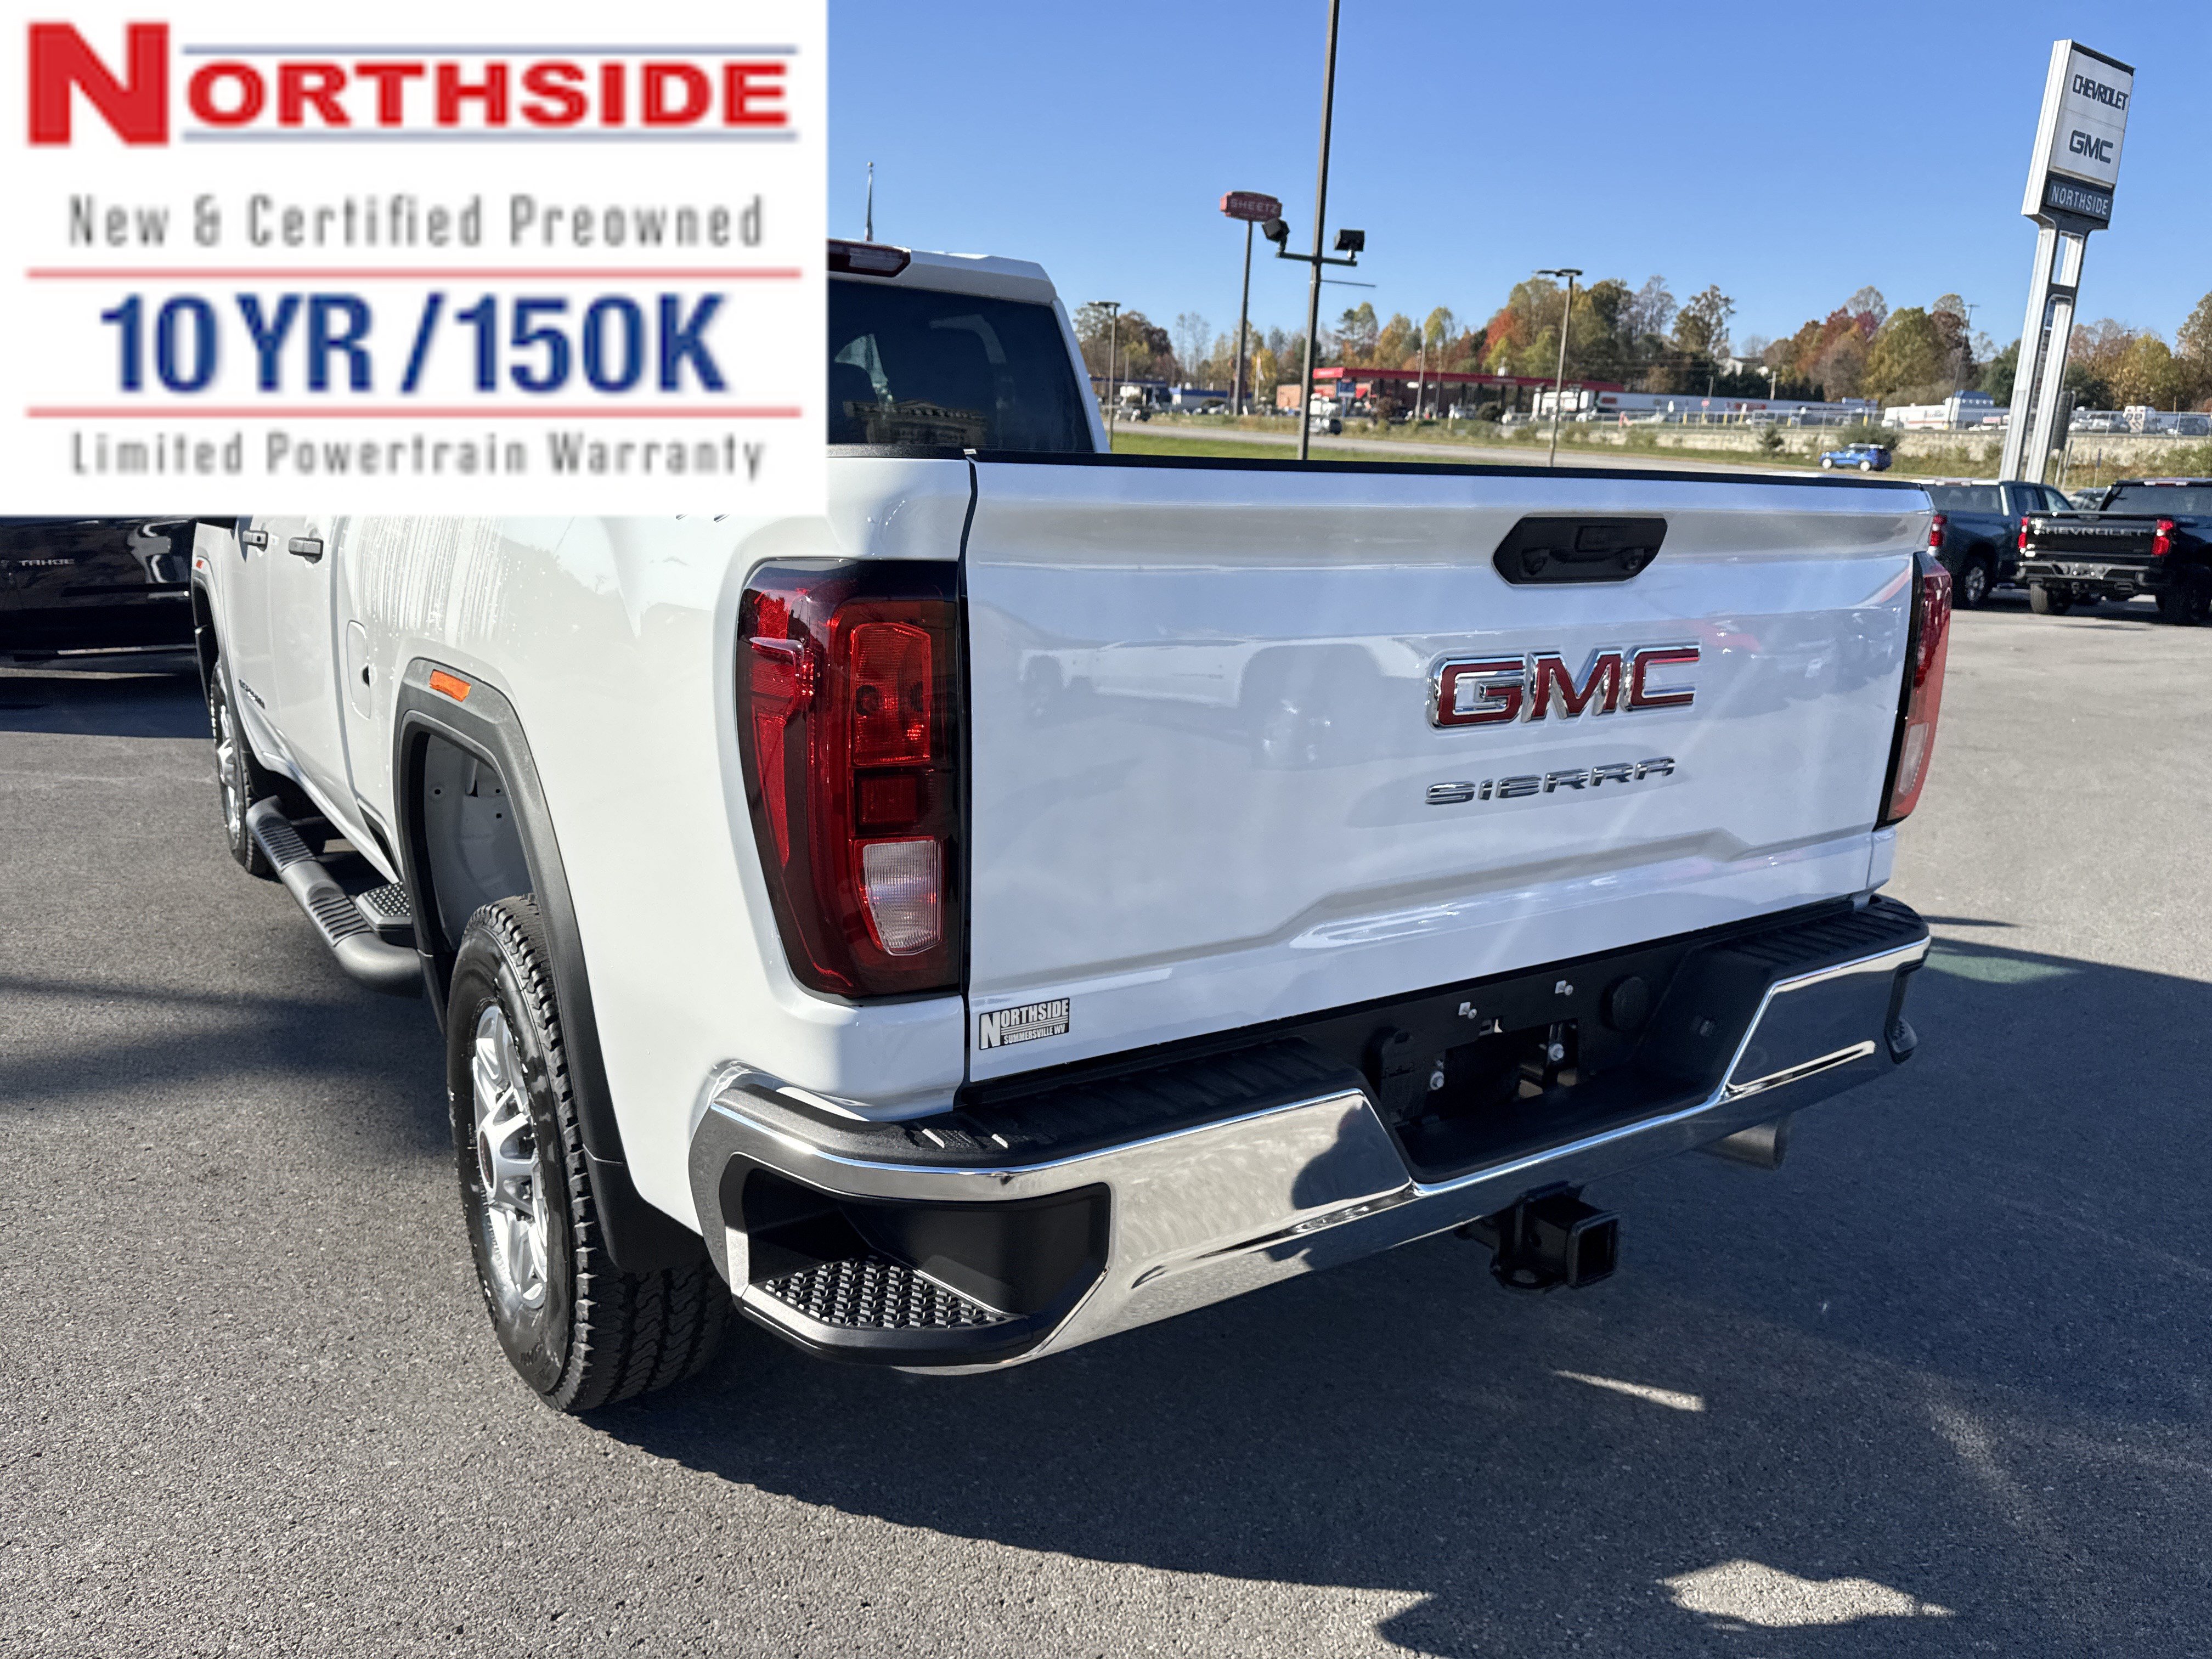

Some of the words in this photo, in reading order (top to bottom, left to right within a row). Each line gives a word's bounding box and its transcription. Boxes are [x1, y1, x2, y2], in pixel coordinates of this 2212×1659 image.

[2072, 74, 2129, 111] CHEVROLET
[2069, 129, 2114, 164] GMC
[1230, 198, 1278, 215] SHEETZ
[2051, 185, 2109, 216] NORTHSIDE
[1427, 641, 1701, 730] GMC
[1425, 756, 1675, 805] SIERRA
[980, 999, 1069, 1049] NORTHSIDE
[1003, 1025, 1054, 1045] SUMMERSVILLE
[1053, 1024, 1066, 1035] WV
